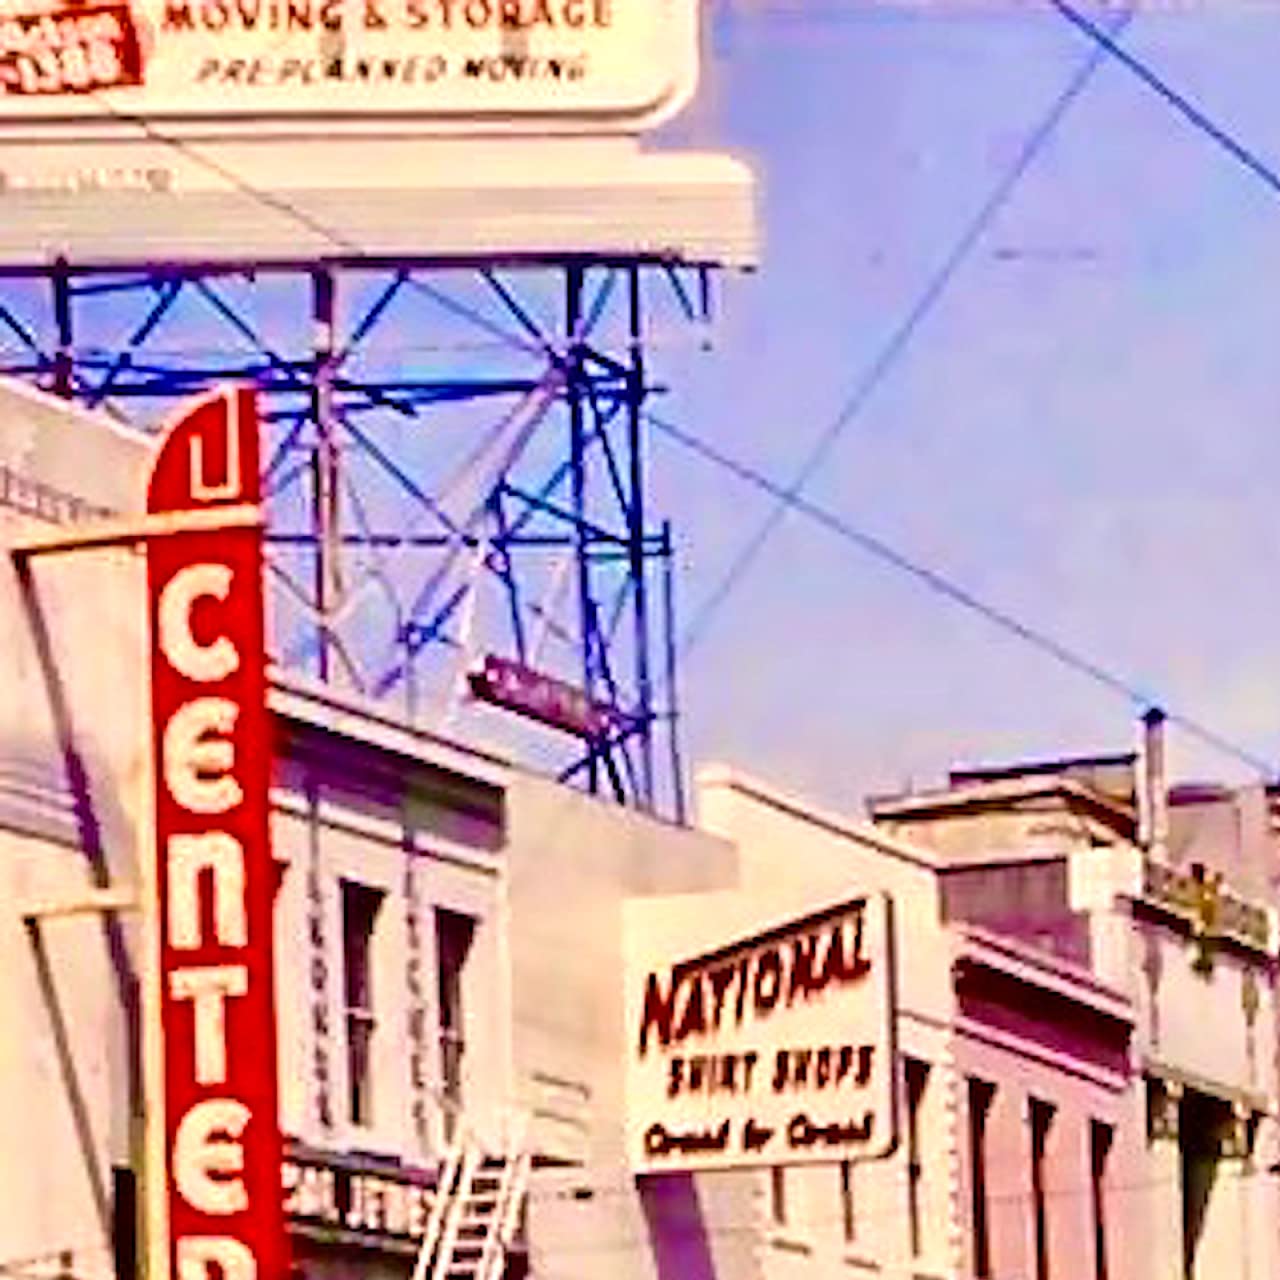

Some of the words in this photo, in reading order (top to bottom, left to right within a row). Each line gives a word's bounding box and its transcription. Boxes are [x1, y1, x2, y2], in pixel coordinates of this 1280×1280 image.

[160, 0, 344, 31] MOVING
[403, 0, 614, 30] STORAGE
[462, 54, 586, 82] MOVING
[638, 918, 871, 1057] NATIONAL
[668, 1051, 758, 1098] SHIRT
[772, 1045, 876, 1093] SHOPS
